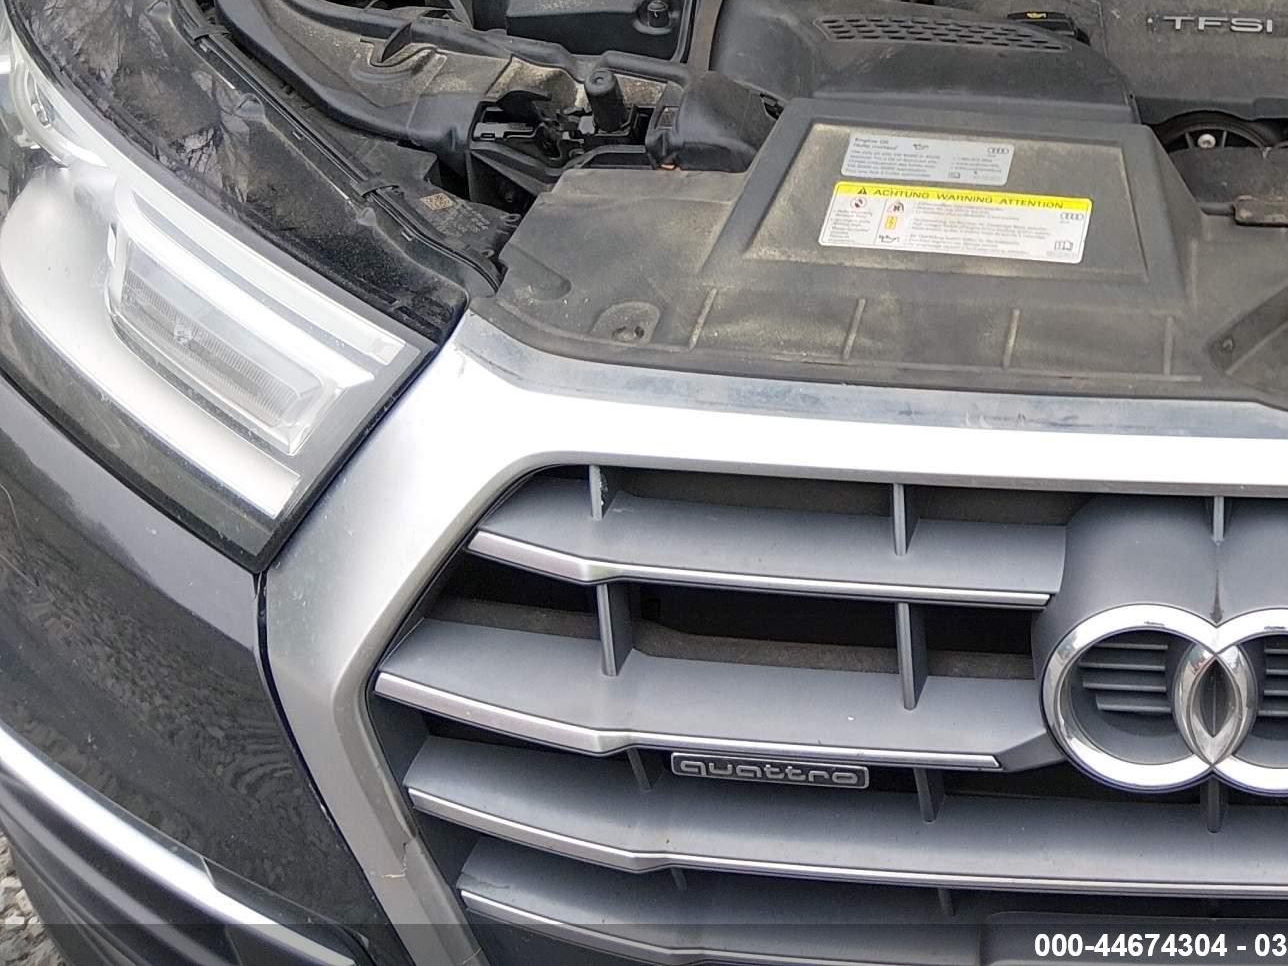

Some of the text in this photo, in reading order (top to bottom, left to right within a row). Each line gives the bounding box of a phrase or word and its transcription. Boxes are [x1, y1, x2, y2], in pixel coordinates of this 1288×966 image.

[1163, 15, 1274, 34] TFSI
[873, 188, 1064, 209] ACHTUNG WARNING ATTENTION
[680, 759, 858, 784] quattro
